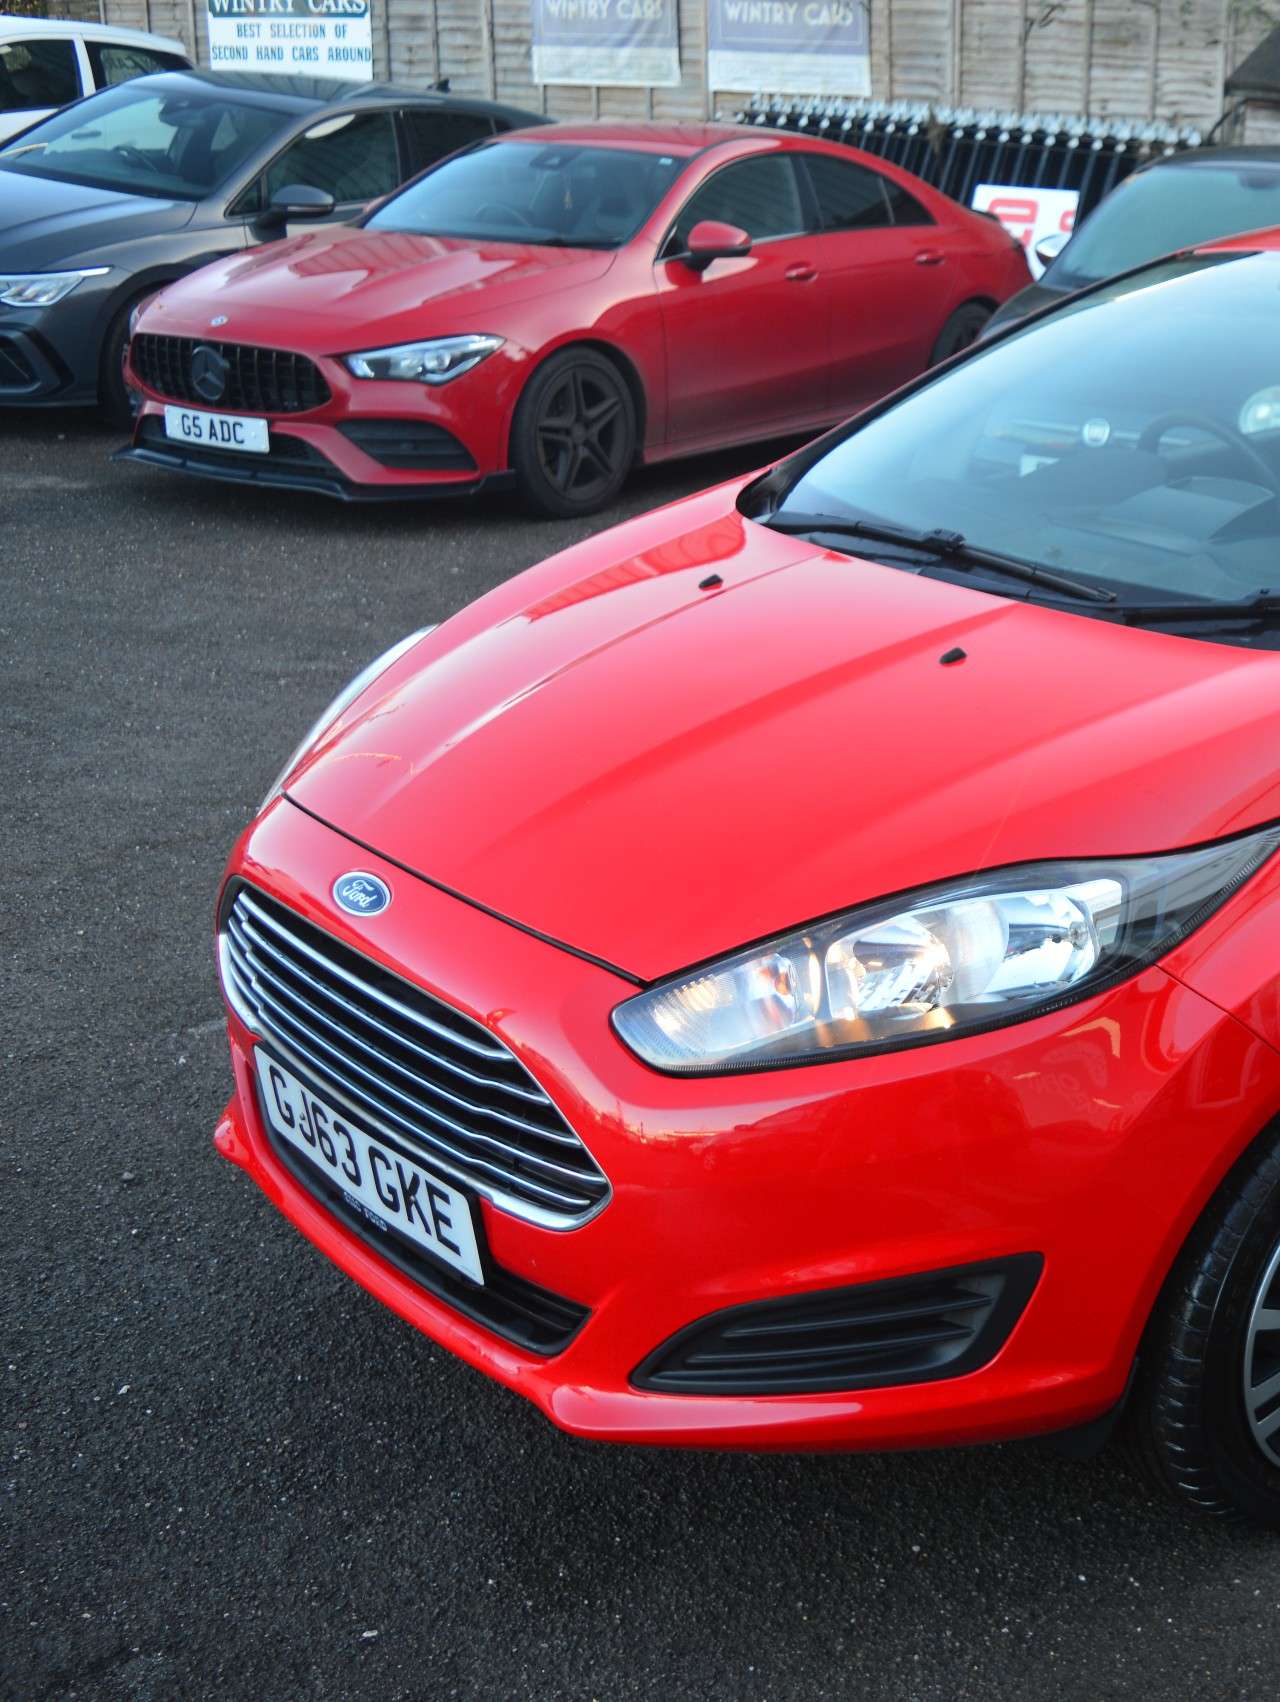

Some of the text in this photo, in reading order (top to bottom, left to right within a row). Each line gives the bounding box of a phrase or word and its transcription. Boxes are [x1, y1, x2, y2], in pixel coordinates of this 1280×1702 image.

[212, 0, 366, 14] WINTRY CARS
[546, 0, 608, 20] WINTRY
[724, 2, 797, 24] WINTRY
[236, 23, 348, 38] BEST SELECTION OF
[212, 46, 371, 62] SECOND HAND CARS AROUND
[182, 413, 245, 444] G5 ADC
[342, 879, 378, 908] Ford
[269, 1065, 462, 1257] GJ63 GKE
